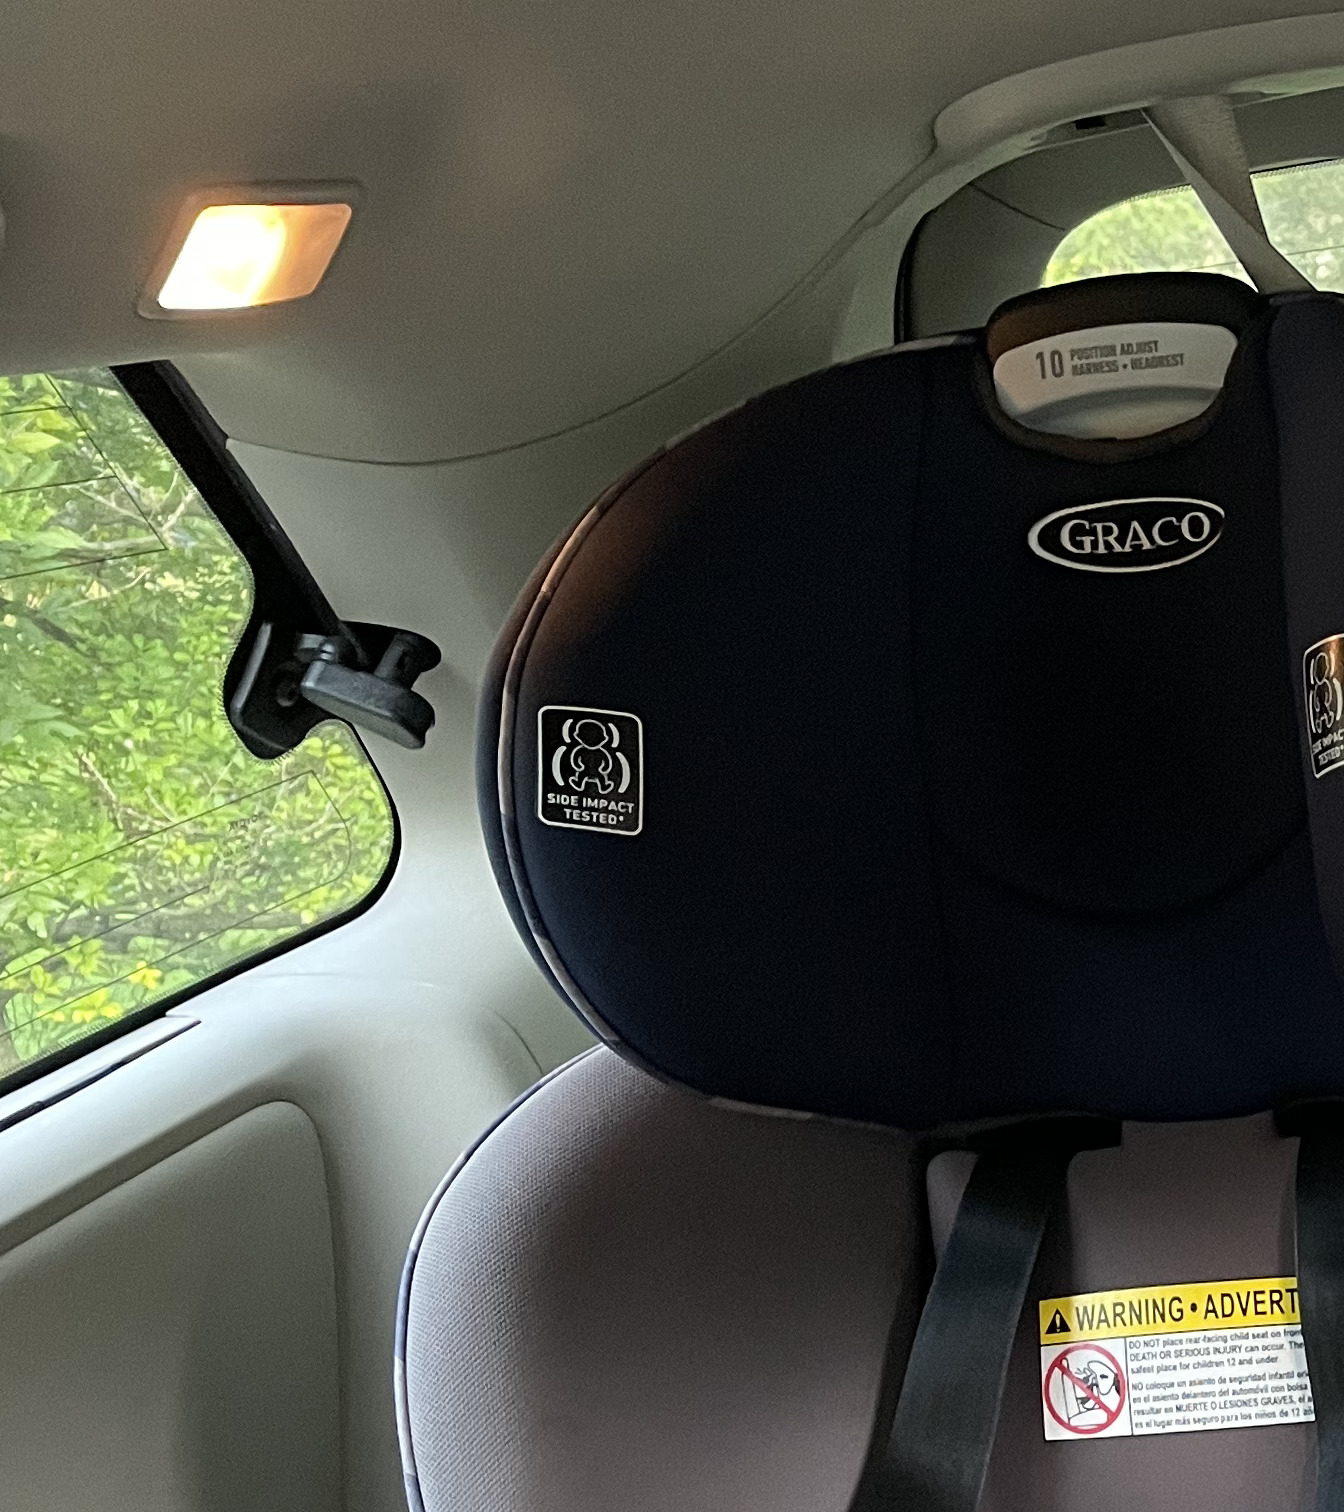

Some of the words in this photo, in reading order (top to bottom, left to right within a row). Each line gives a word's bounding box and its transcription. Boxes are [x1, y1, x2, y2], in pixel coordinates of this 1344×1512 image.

[1070, 344, 1117, 361] POSITION
[1120, 340, 1159, 356] ADJUST
[1035, 349, 1064, 379] 10
[1072, 360, 1119, 376] HARNESS
[1130, 353, 1185, 370] HEADREST
[1060, 511, 1211, 555] GRACO
[547, 792, 579, 807] SIDE
[582, 797, 635, 814] IMPACT
[1075, 1296, 1185, 1331] WARNING
[1203, 1288, 1300, 1320] ADVERT
[1129, 1340, 1141, 1349] DO
[1143, 1338, 1160, 1348] NOT
[1163, 1338, 1184, 1349] place
[1230, 1331, 1250, 1342] child
[1252, 1331, 1268, 1339] seat
[1130, 1352, 1157, 1362] DEATH
[1159, 1350, 1172, 1360] OR
[1174, 1347, 1210, 1358] SERIOUS
[1213, 1344, 1243, 1355] INJURY
[1131, 1364, 1154, 1374] safest
[1156, 1363, 1177, 1374] place
[1180, 1362, 1190, 1370] for
[1192, 1359, 1224, 1370] children
[1226, 1358, 1236, 1366] 12
[1238, 1356, 1253, 1366] and
[1132, 1382, 1143, 1391] NO
[1146, 1380, 1174, 1391] coloque
[1189, 1377, 1216, 1387] asiento
[1218, 1376, 1226, 1384] de
[1229, 1372, 1266, 1385] seguridad
[1152, 1393, 1180, 1402] asiento
[1181, 1390, 1216, 1400] delantero
[1218, 1388, 1230, 1397] del
[1134, 1406, 1162, 1416] resultar
[1176, 1402, 1208, 1412] MUERTE
[1210, 1401, 1217, 1410] O
[1218, 1398, 1259, 1410] LESIONES
[1193, 1416, 1220, 1426] seguro
[1220, 1414, 1238, 1424] para
[1240, 1412, 1252, 1420] los
[1279, 1409, 1288, 1418] de
[1291, 1408, 1300, 1416] 12
